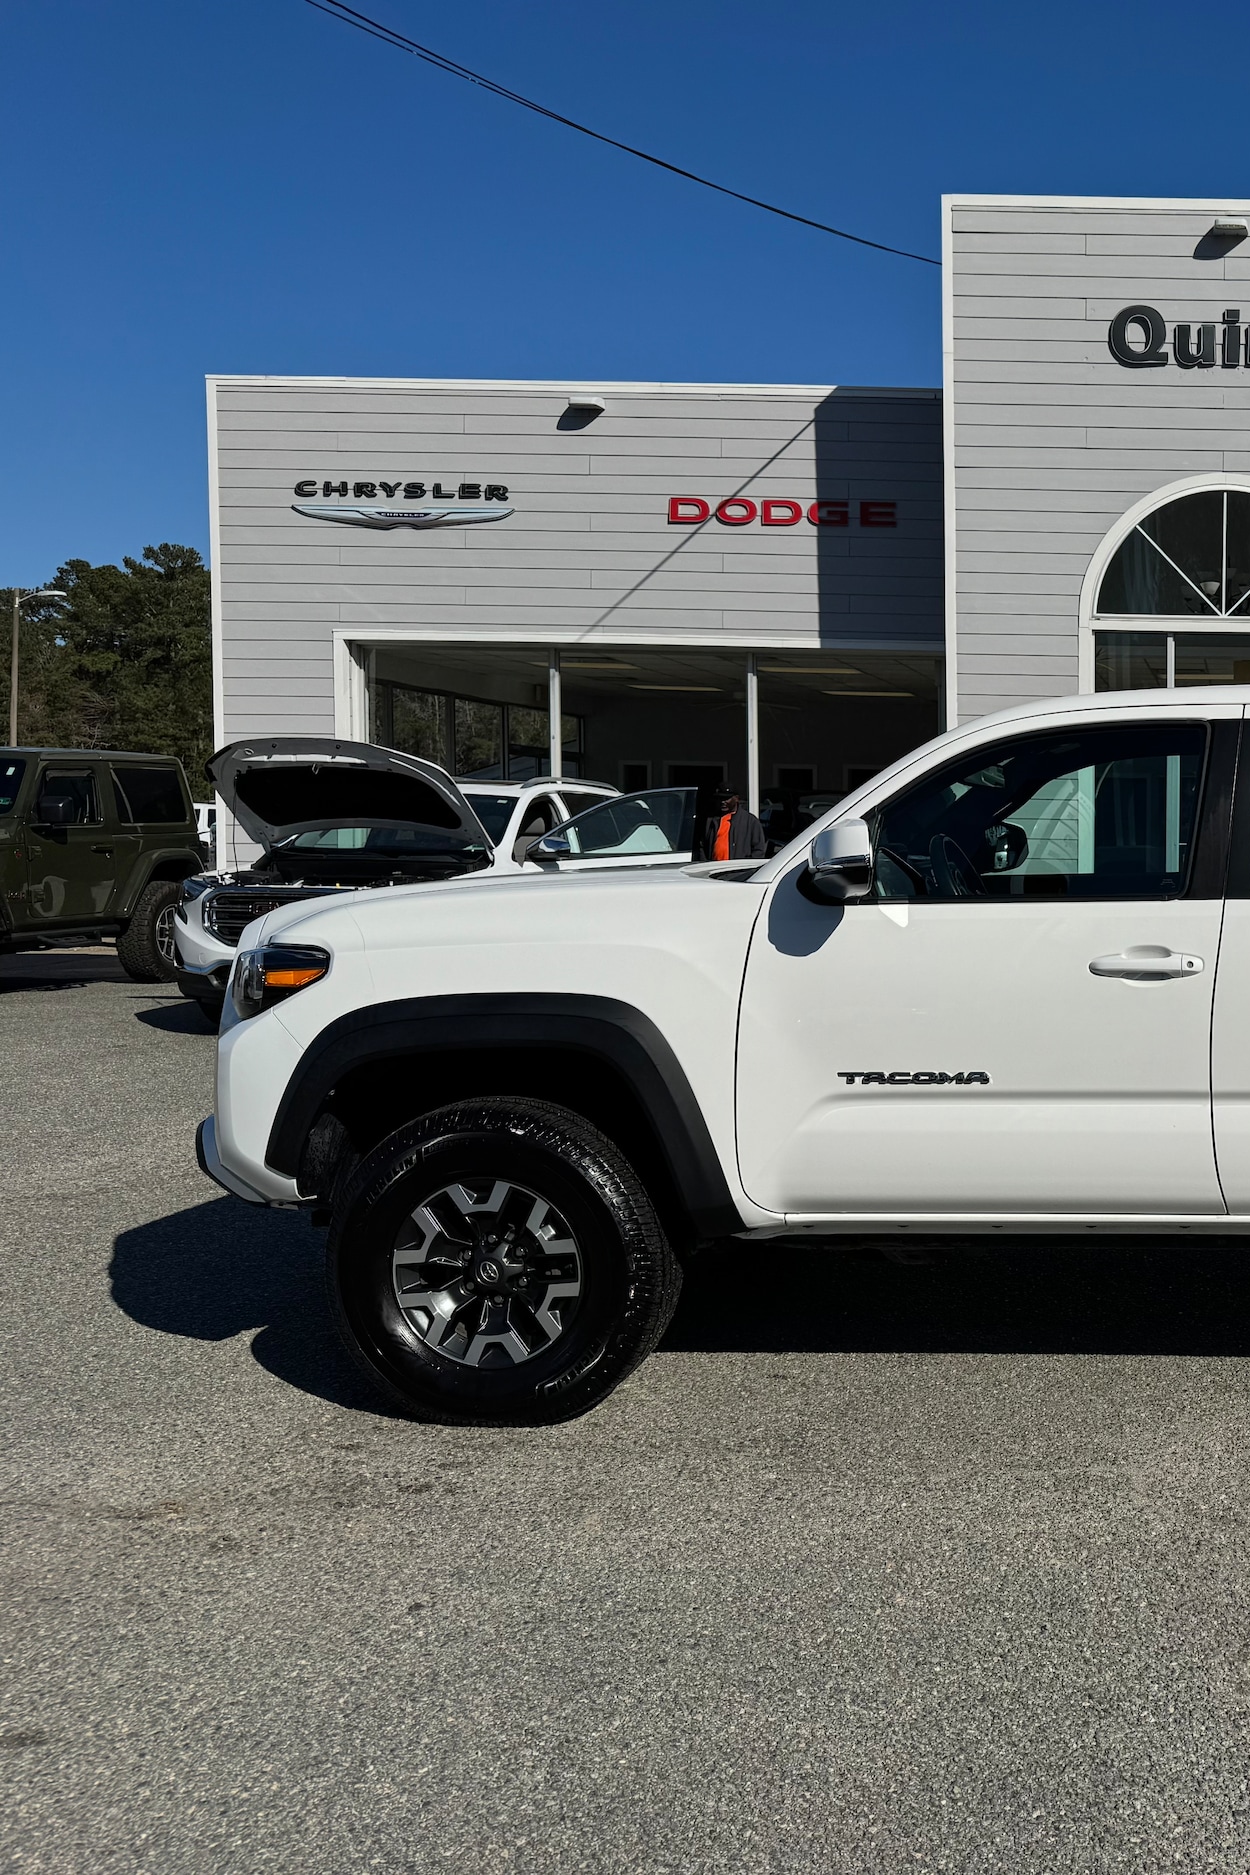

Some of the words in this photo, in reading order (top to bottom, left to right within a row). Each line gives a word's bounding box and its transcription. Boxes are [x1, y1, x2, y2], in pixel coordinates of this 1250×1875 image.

[294, 480, 509, 501] CHRYSLER
[667, 497, 898, 527] DODGE
[837, 1072, 990, 1085] TACOMA
